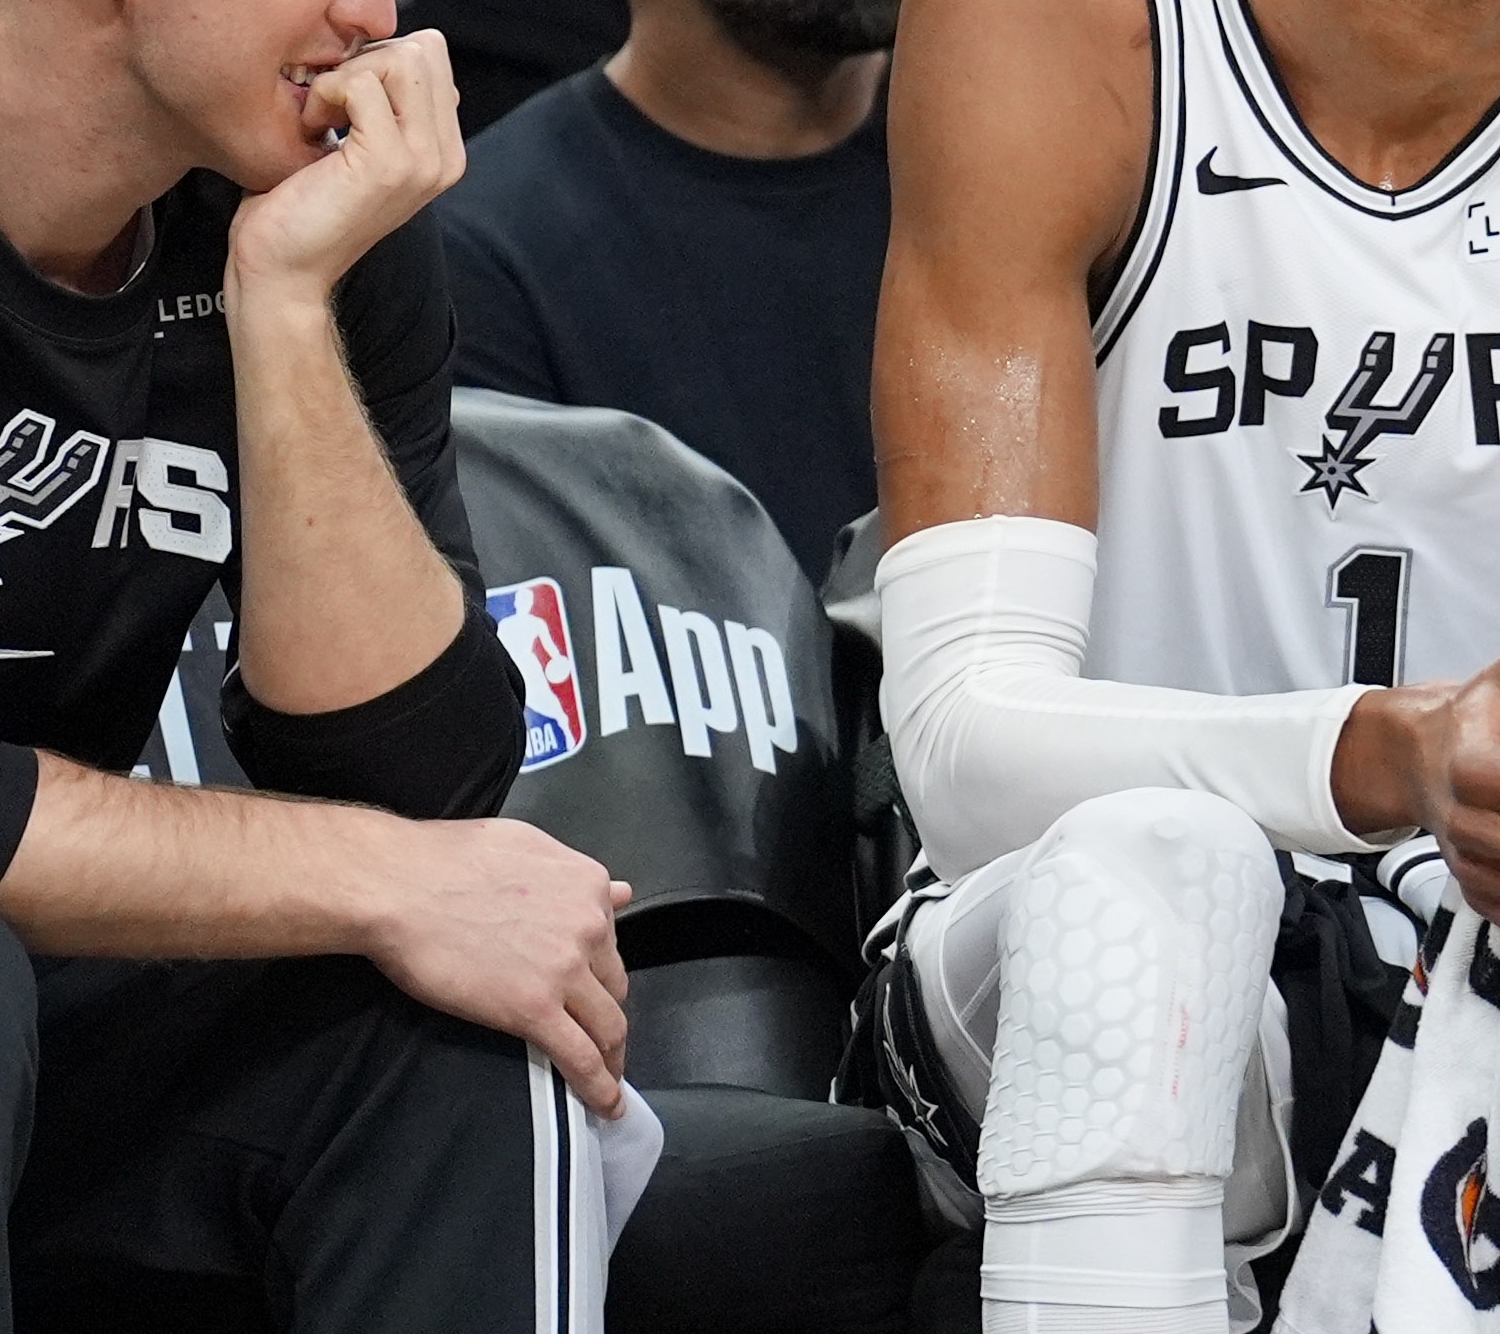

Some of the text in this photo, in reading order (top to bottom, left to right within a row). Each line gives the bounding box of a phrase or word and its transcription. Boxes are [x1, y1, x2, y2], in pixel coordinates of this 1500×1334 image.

[157, 290, 226, 322] LEDG
[591, 566, 799, 775] App
[1327, 545, 1414, 689] 1
